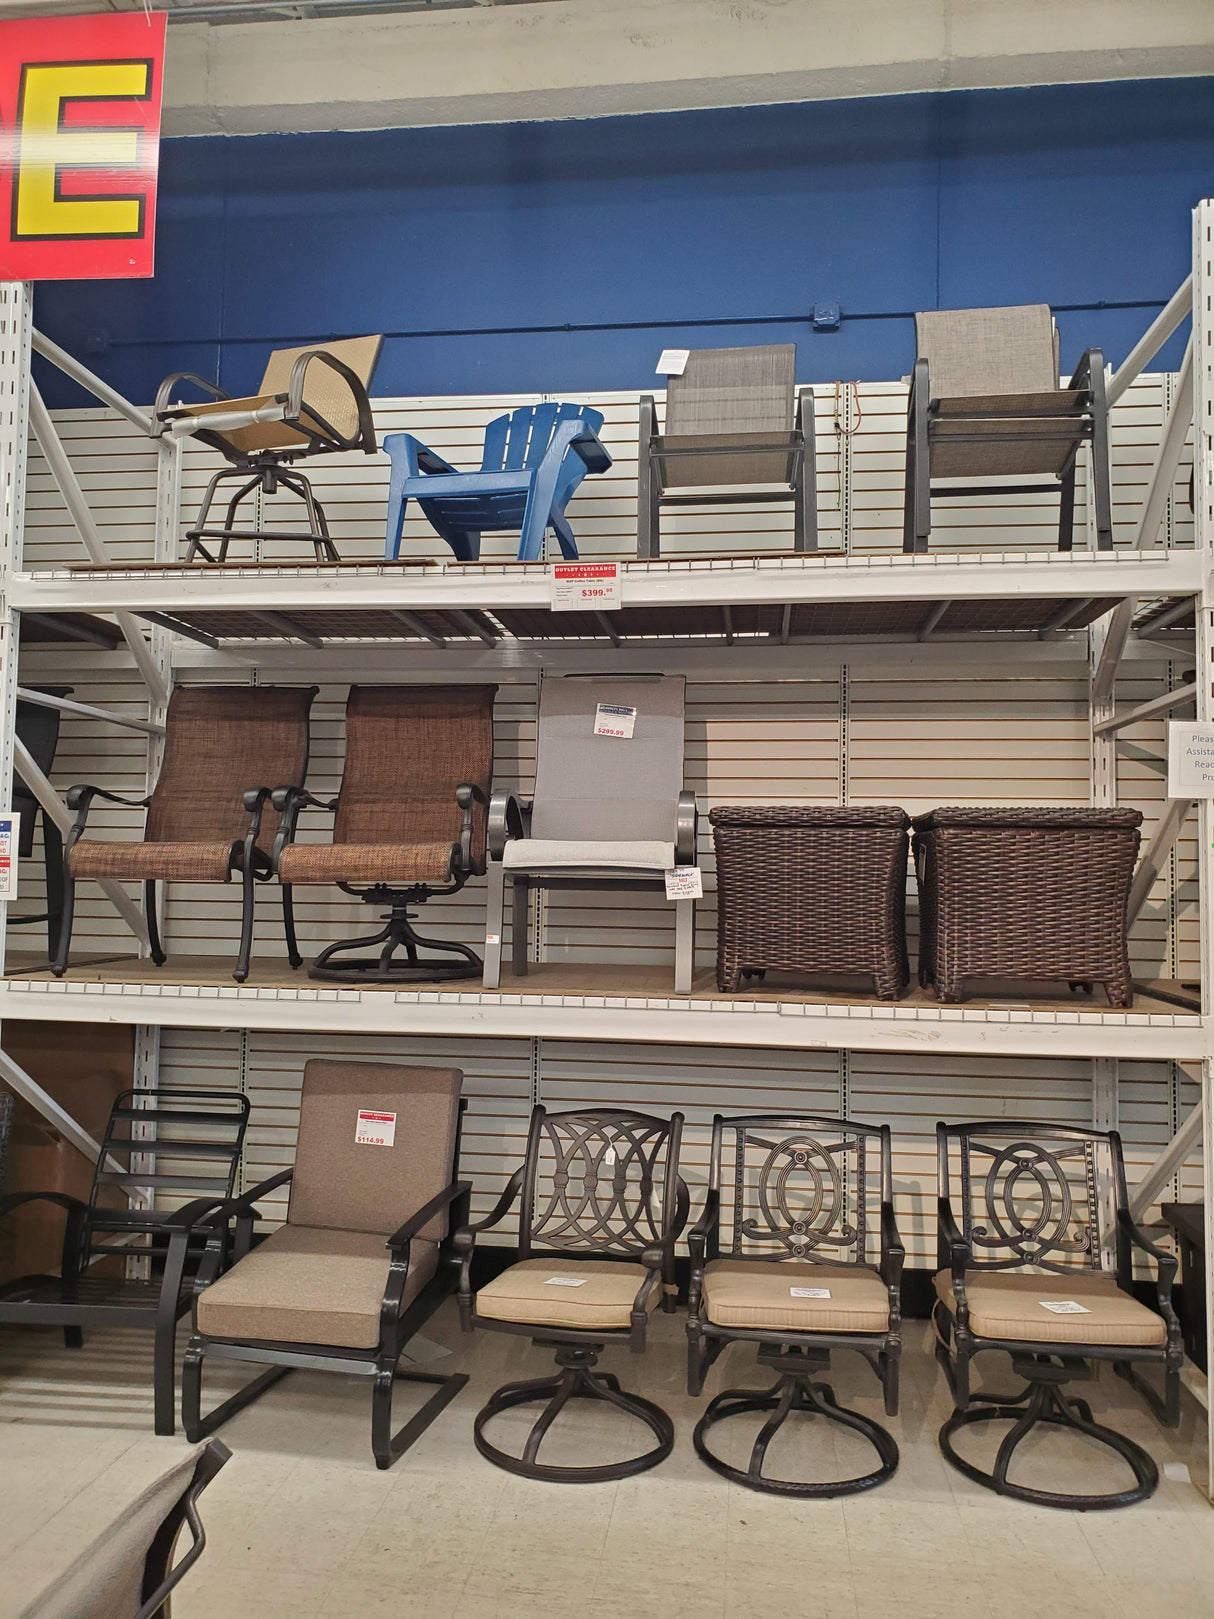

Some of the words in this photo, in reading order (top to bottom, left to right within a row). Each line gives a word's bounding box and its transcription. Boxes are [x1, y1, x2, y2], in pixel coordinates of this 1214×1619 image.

[9, 58, 154, 242] E
[1192, 735, 1214, 743] Pleas
[1186, 747, 1214, 755] Assista
[1194, 760, 1214, 768] Reac
[357, 1136, 384, 1144] $114.99
